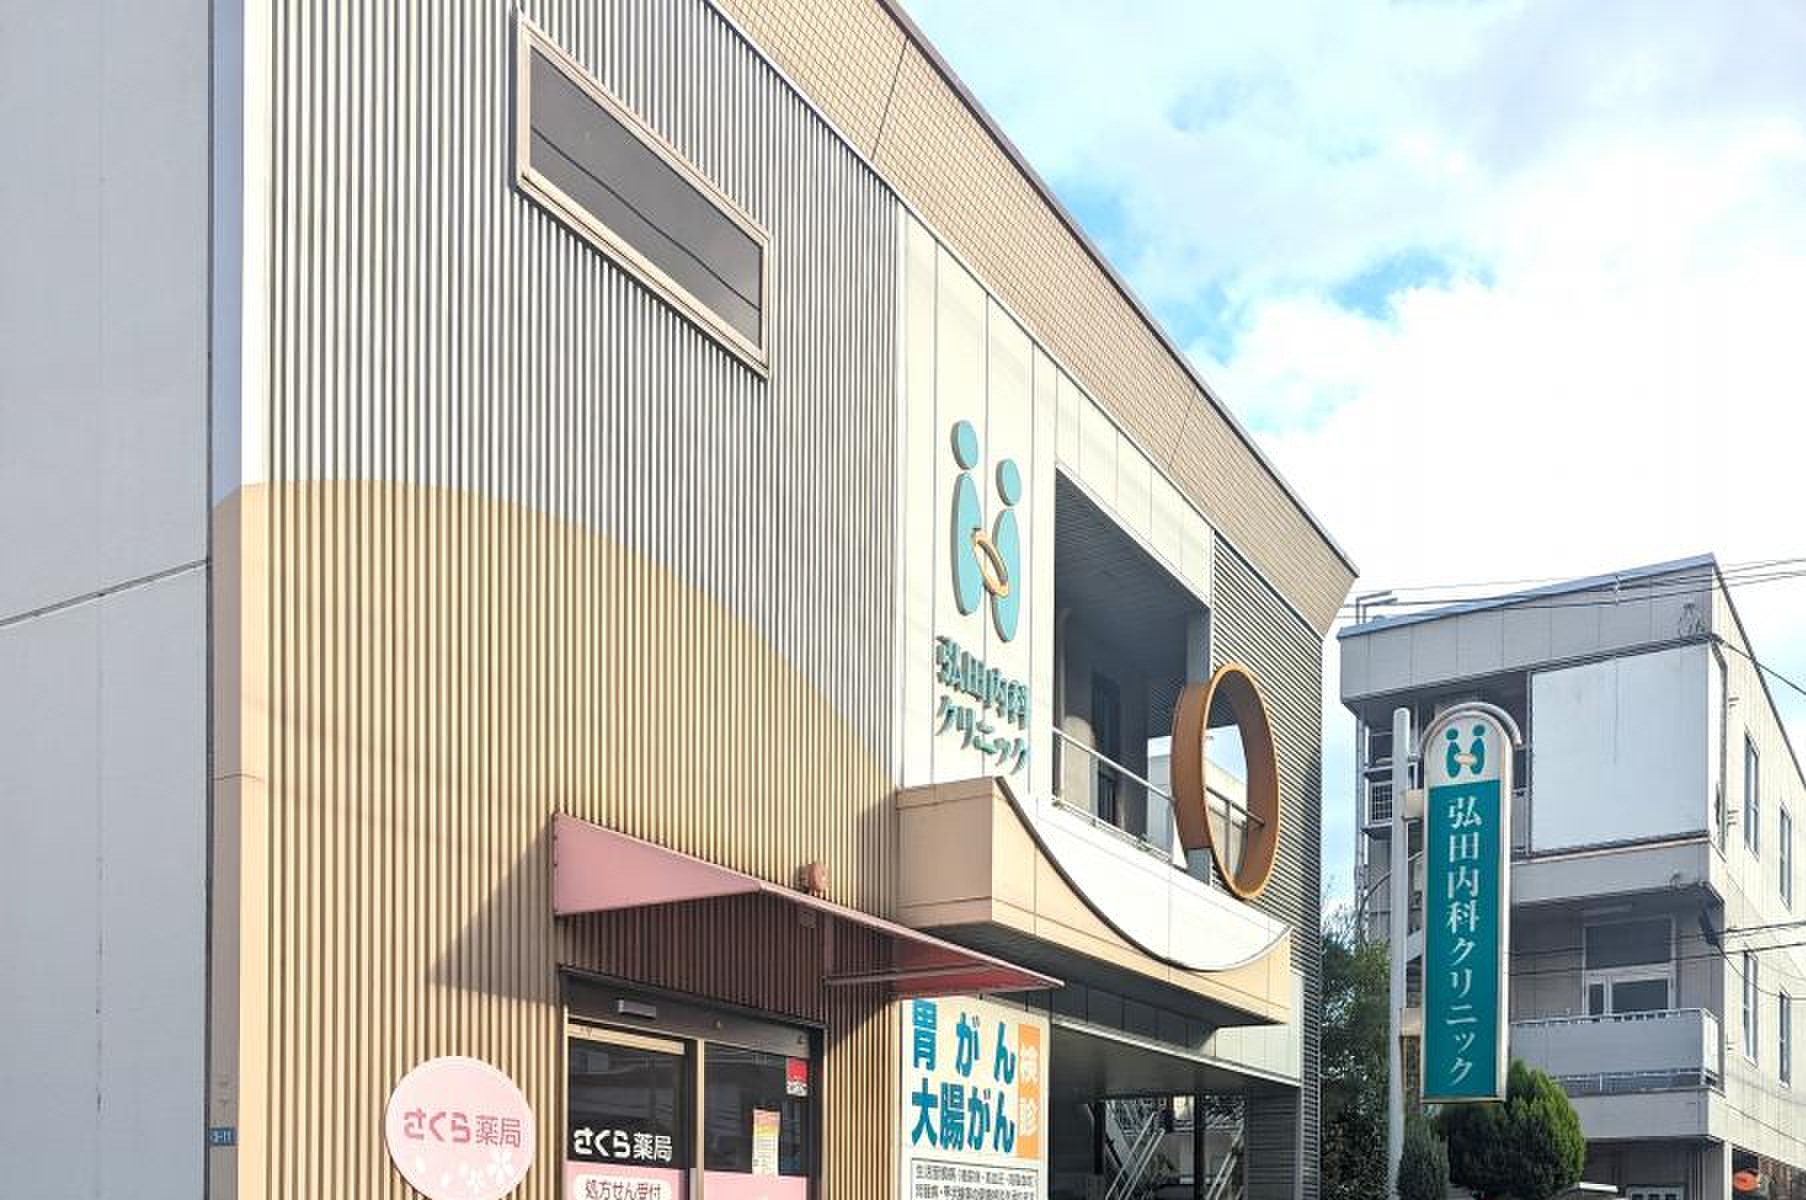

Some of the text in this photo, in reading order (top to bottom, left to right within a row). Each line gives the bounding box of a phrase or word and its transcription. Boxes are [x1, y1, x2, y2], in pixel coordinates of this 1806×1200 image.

[936, 635, 1028, 731] 弘田内科
[935, 694, 1027, 776] クリニック
[1445, 796, 1483, 1086] 弘田内科クリニック
[912, 998, 1017, 1085] 胃がん
[402, 1107, 521, 1149] さくら薬局
[573, 1128, 673, 1163] さくら薬局
[911, 1077, 1017, 1154] 大腸がん
